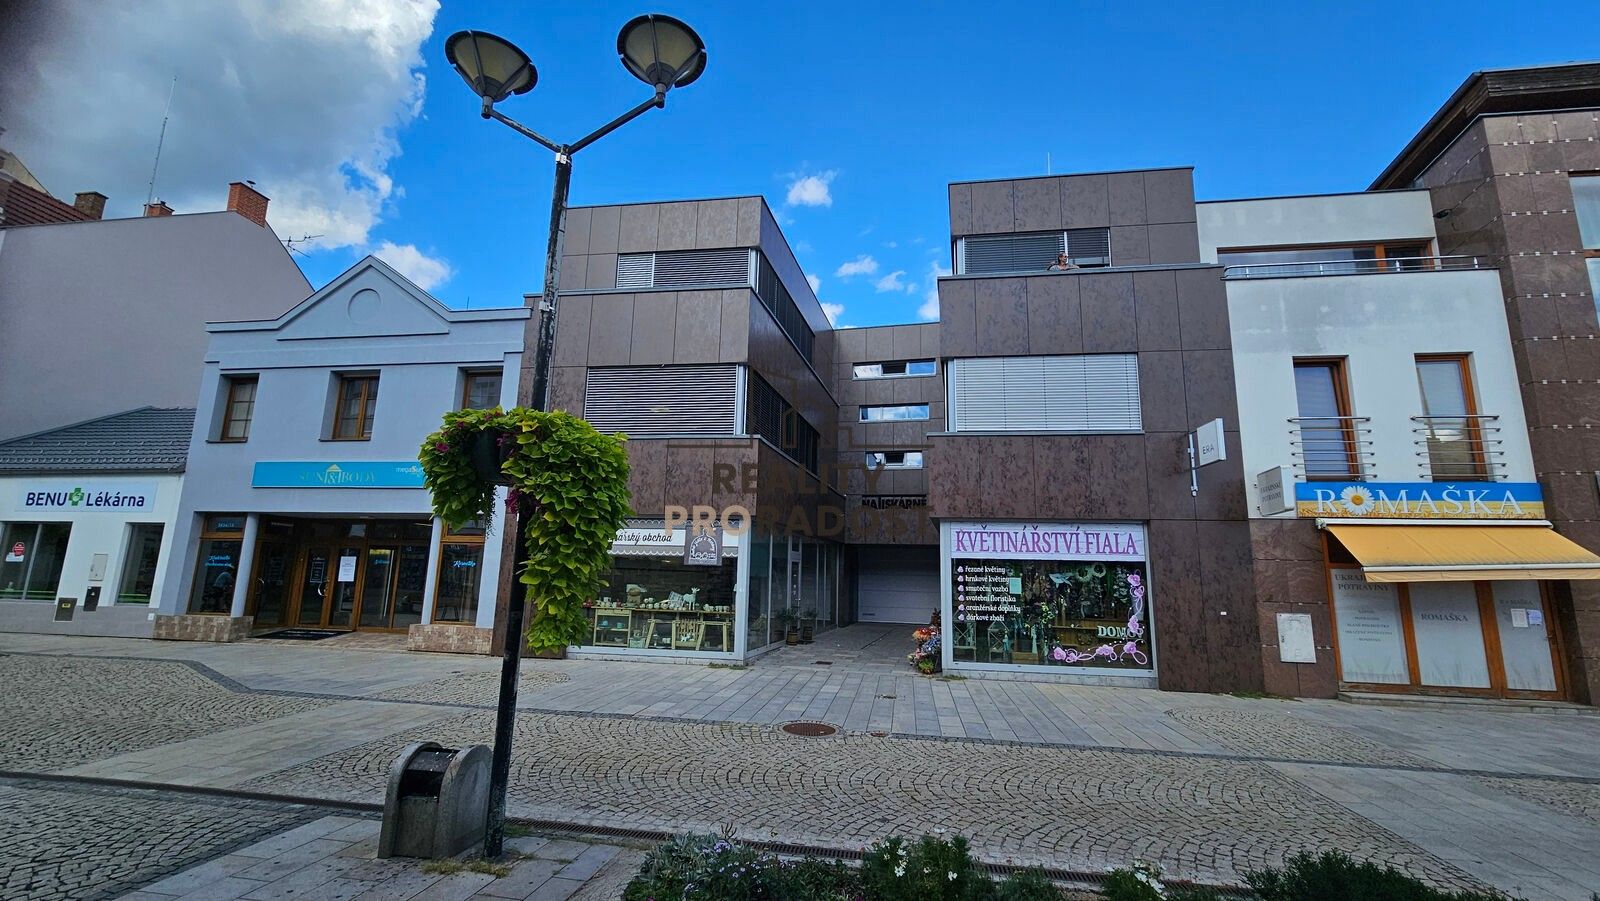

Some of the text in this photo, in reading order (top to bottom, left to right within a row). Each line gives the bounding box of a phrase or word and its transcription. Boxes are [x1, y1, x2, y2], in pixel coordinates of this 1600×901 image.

[1202, 444, 1215, 455] ERA
[25, 491, 146, 507] BENU Lékárna
[955, 525, 1139, 555] KVĚTINÁŘSTVÍ FIALA
